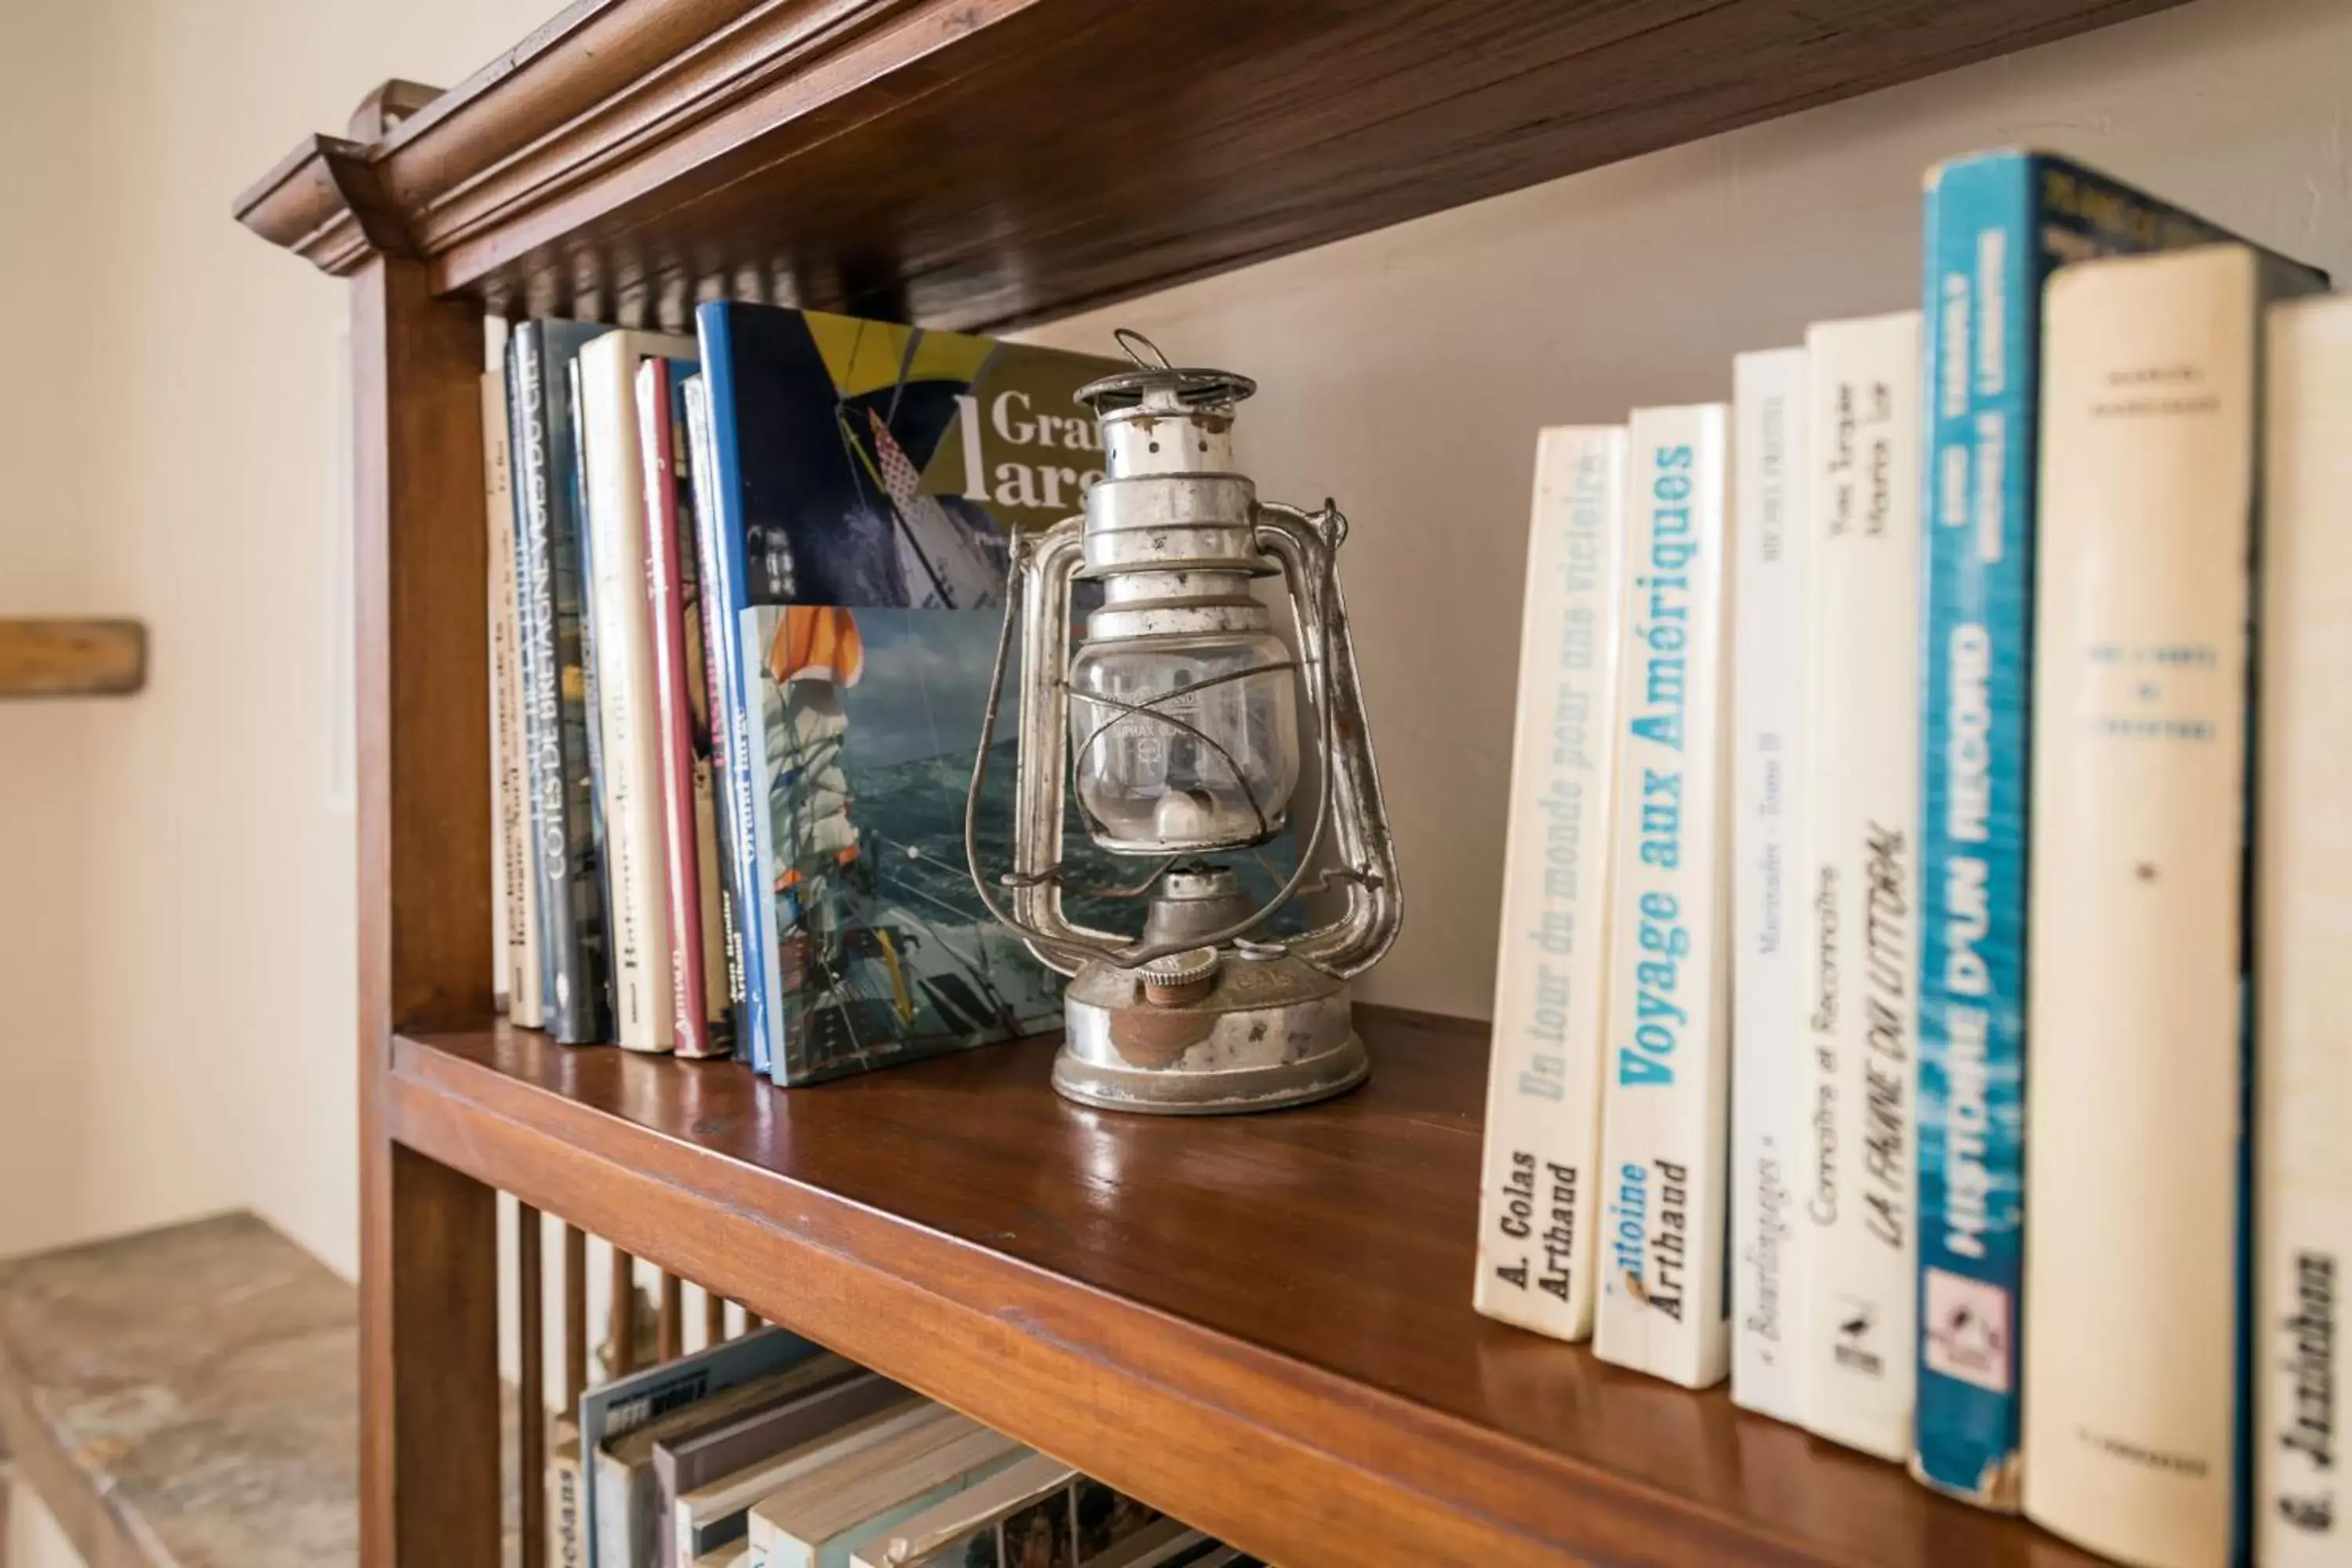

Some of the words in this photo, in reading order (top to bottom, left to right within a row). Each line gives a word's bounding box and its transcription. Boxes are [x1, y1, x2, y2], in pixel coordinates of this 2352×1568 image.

[991, 390, 1105, 452] Gra
[1631, 444, 1697, 753] Amériques
[1553, 683, 1592, 771] pour
[1947, 622, 1991, 844] RECORD
[1538, 778, 1584, 900] monde
[1640, 769, 1684, 870] aux
[1530, 909, 1573, 953] du
[1864, 821, 1907, 996] LITTORAL
[1945, 861, 1991, 997] D'UN
[1534, 965, 1571, 1043] tour
[1618, 892, 1688, 1090] Voyage
[1520, 1053, 1566, 1102] Un
[1863, 1064, 1905, 1180] FAUNE
[1944, 1010, 1991, 1258] HISTOIRE
[1501, 1151, 1537, 1237] Colas
[1540, 1163, 1579, 1303] Arthaud
[1647, 1160, 1689, 1323] Arthaud
[1862, 1186, 1905, 1251] LA
[1496, 1257, 1531, 1290] A.
